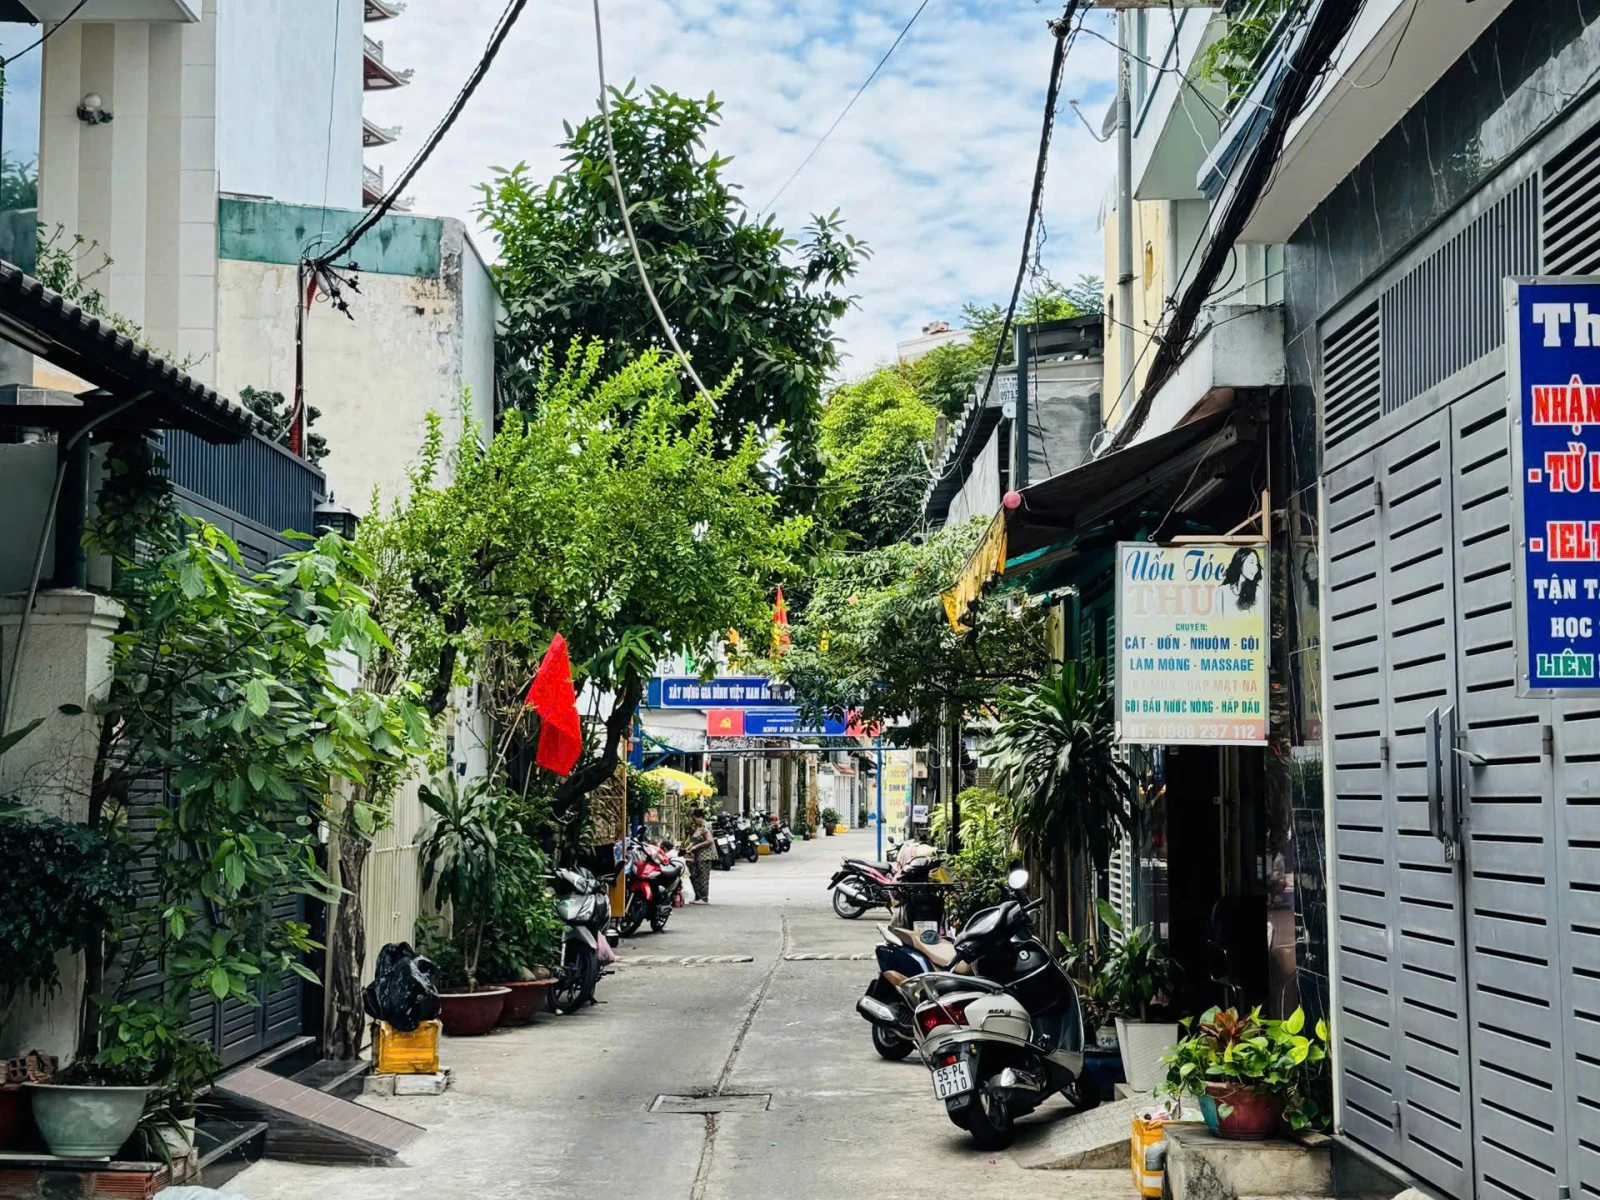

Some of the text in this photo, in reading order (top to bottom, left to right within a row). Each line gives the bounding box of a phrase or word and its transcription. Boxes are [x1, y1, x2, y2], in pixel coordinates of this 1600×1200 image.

[1532, 374, 1600, 436] NHẬN
[1545, 442, 1586, 493] TỪ
[1125, 549, 1225, 582] Uốn Tóc
[1533, 573, 1577, 605] TẬN
[1550, 617, 1593, 644] HỌC
[1190, 636, 1230, 653] NHUỘM
[1241, 635, 1259, 653] GỘI
[1201, 658, 1254, 672] MASSAGE
[1536, 648, 1594, 678] LIÊN
[729, 683, 745, 702] VIỆT
[745, 686, 760, 700] NAM
[1233, 725, 1256, 740] 112
[937, 1064, 964, 1082] 55-P4
[940, 1077, 968, 1097] 0710
